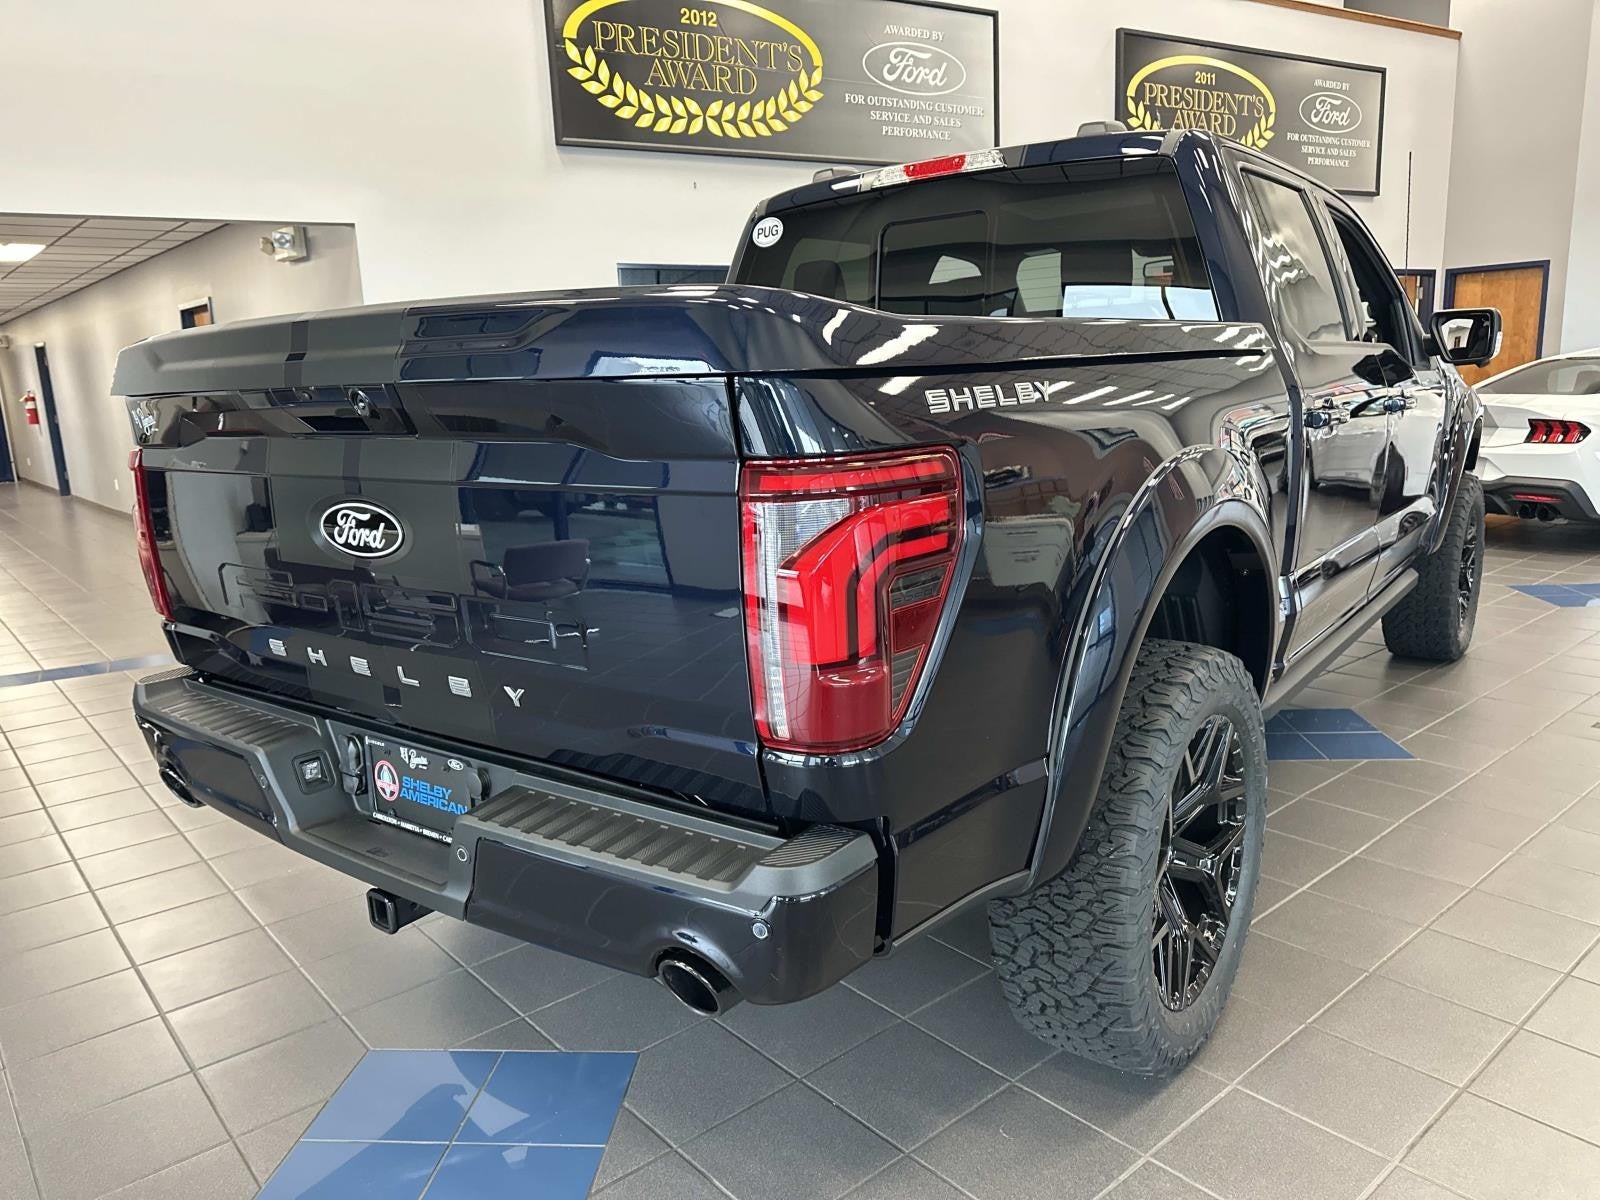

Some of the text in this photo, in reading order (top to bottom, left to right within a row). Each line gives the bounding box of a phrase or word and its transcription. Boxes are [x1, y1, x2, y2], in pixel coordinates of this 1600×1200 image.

[680, 7, 718, 28] 2012
[884, 24, 945, 41] AWARDED BY
[592, 20, 803, 72] PRESIDENT'S
[644, 58, 758, 95] AWARD
[882, 47, 948, 87] Ford
[1195, 71, 1216, 86] 2011
[1314, 79, 1350, 91] AWARDED BY
[844, 93, 985, 116] FOR OUTSTANDING CUSTOMER
[1143, 82, 1265, 118] PRESIDENT'S
[1310, 96, 1351, 126] Ford
[870, 110, 962, 128] SERVICE AND SALES
[1172, 109, 1237, 137] AWARD
[882, 125, 951, 141] PERFORMANCE
[1287, 132, 1300, 141] FOR
[1300, 134, 1340, 145] OUTSTANDING
[1301, 145, 1326, 154] SERVICE
[1327, 147, 1339, 155] AND
[1307, 157, 1350, 168] PERFORMANCE
[756, 224, 779, 240] PUG
[924, 381, 1050, 414] SHELBY
[333, 509, 386, 549] Ford
[268, 638, 525, 708] SHELBY
[402, 776, 452, 800] SHELBY
[400, 788, 468, 815] AMERICAN
